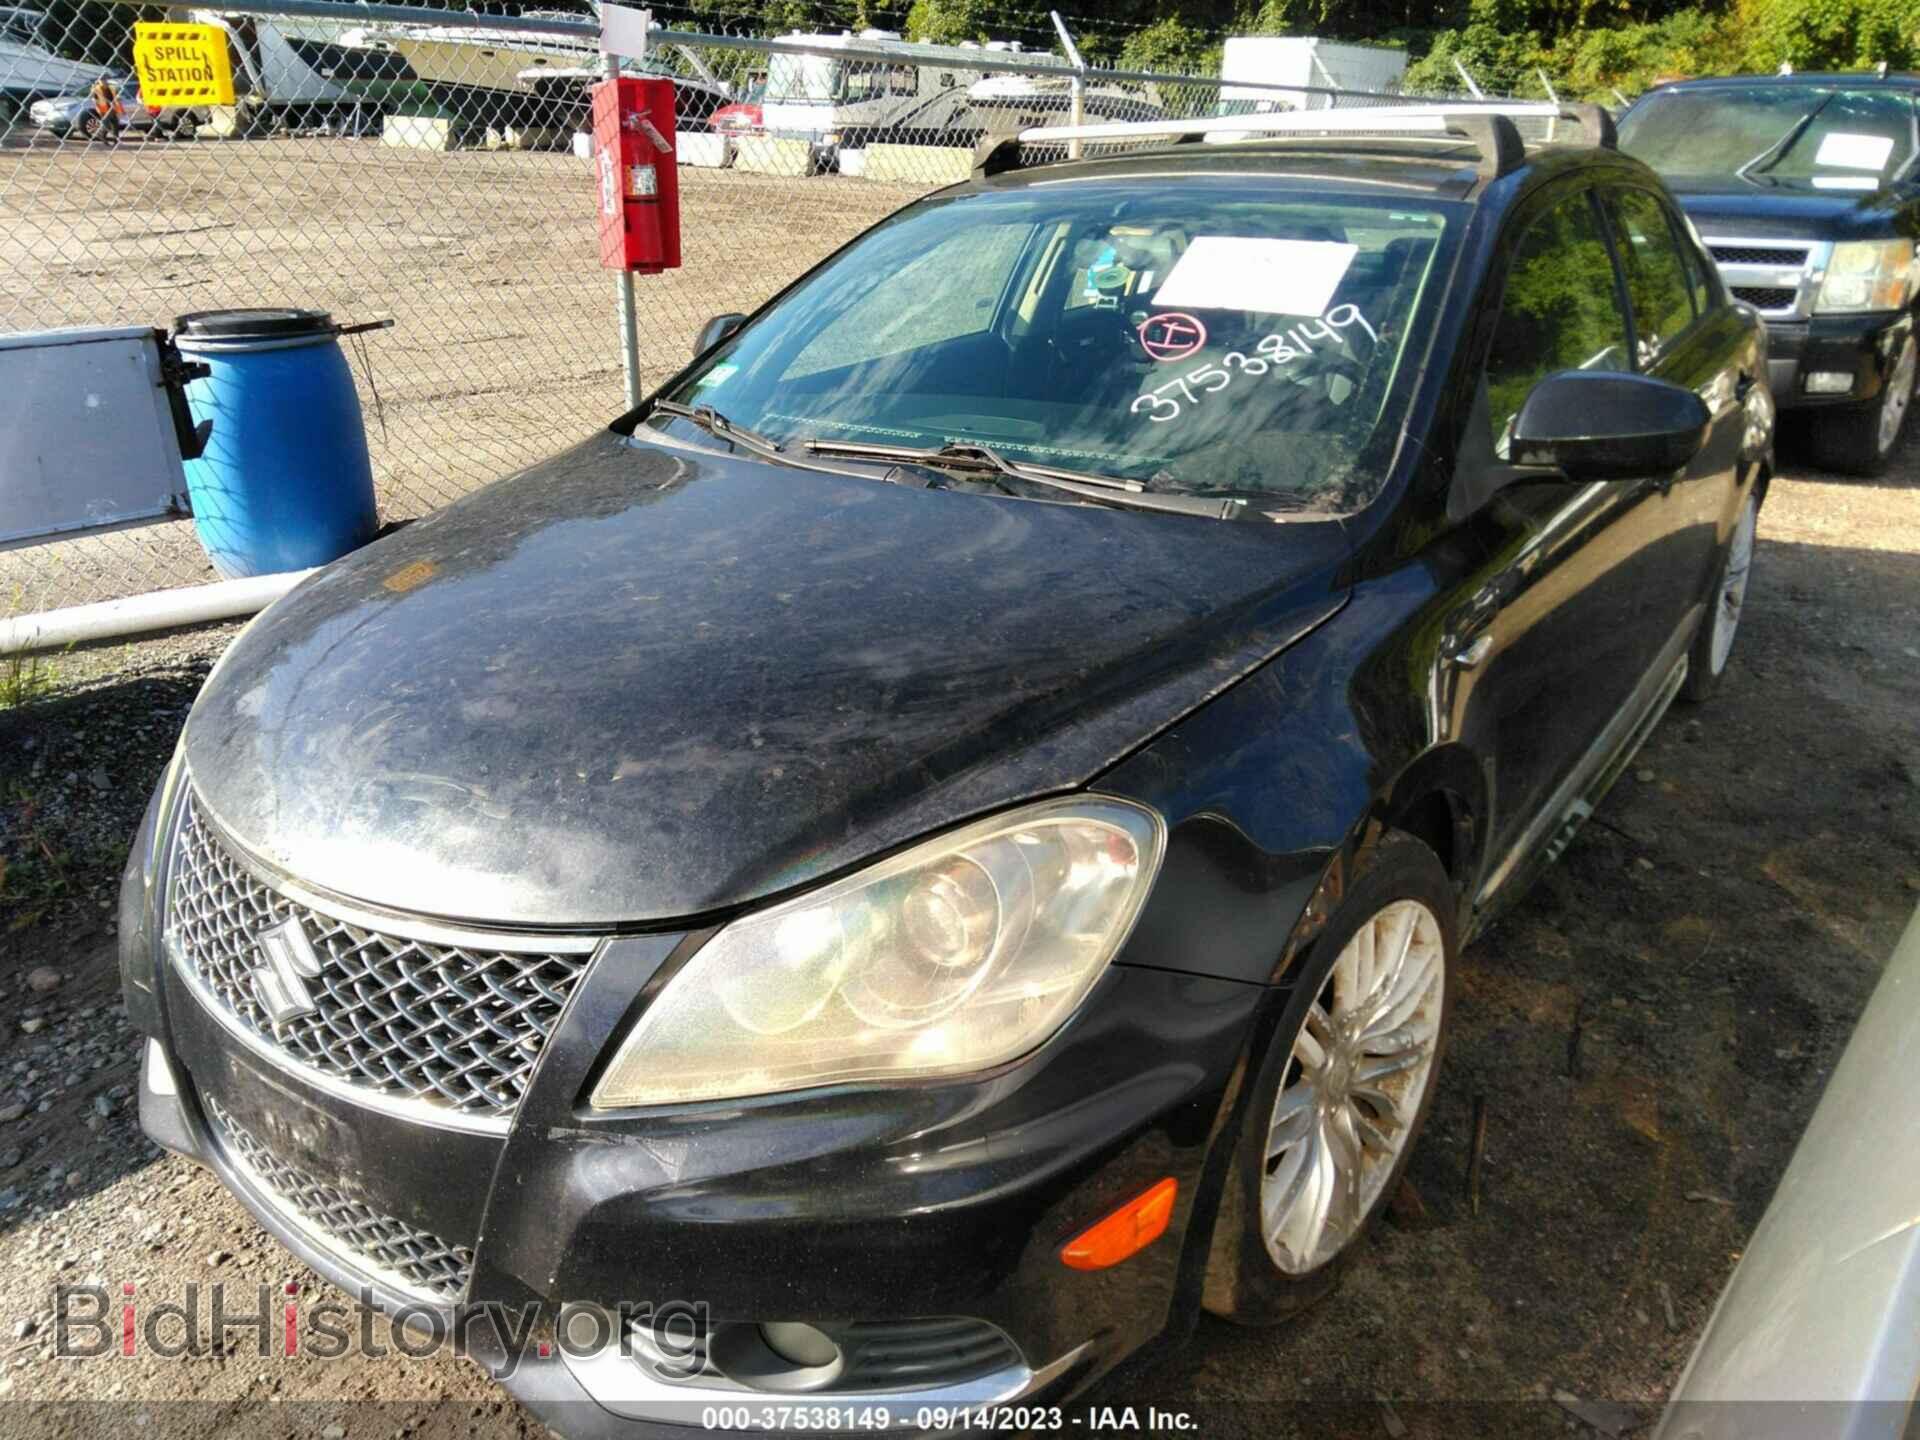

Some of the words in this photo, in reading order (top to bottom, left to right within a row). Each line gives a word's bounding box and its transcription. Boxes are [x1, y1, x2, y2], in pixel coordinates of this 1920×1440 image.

[154, 46, 201, 61] SPILL
[148, 66, 214, 82] STATION
[1131, 304, 1378, 421] 37538149
